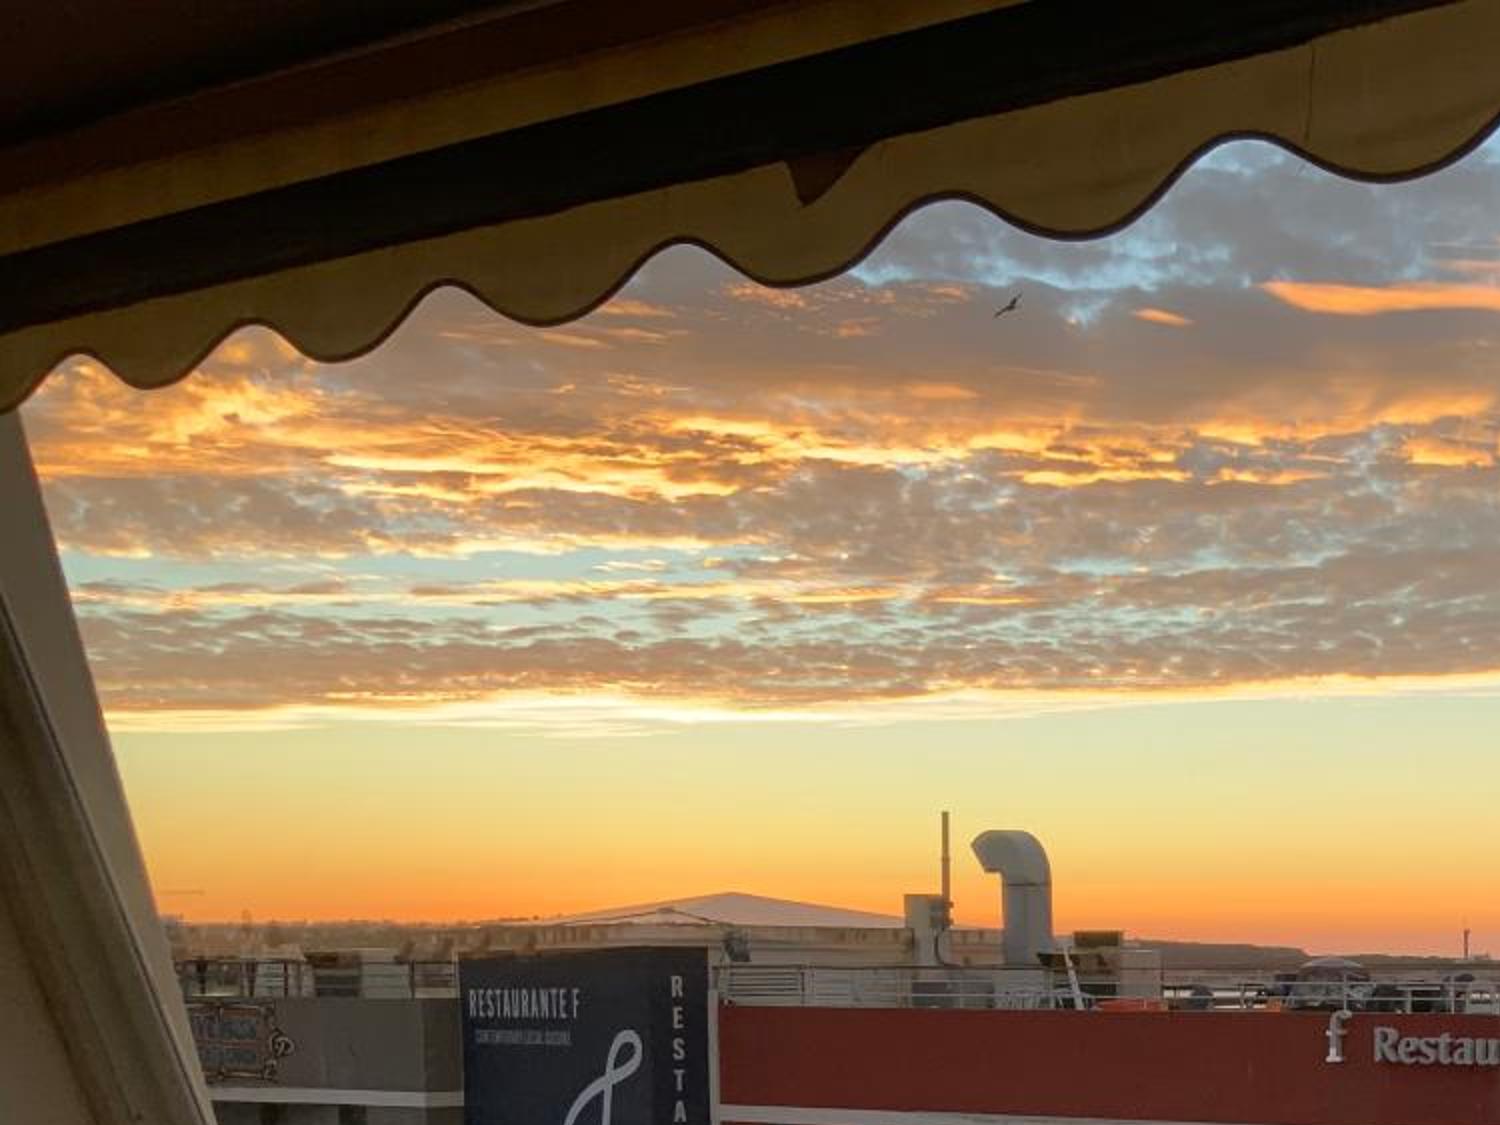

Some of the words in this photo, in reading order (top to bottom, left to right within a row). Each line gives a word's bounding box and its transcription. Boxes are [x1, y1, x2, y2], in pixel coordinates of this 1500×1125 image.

[469, 988, 568, 1019] RESTAURANTE
[571, 988, 581, 1019] F
[1325, 1010, 1353, 1064] f
